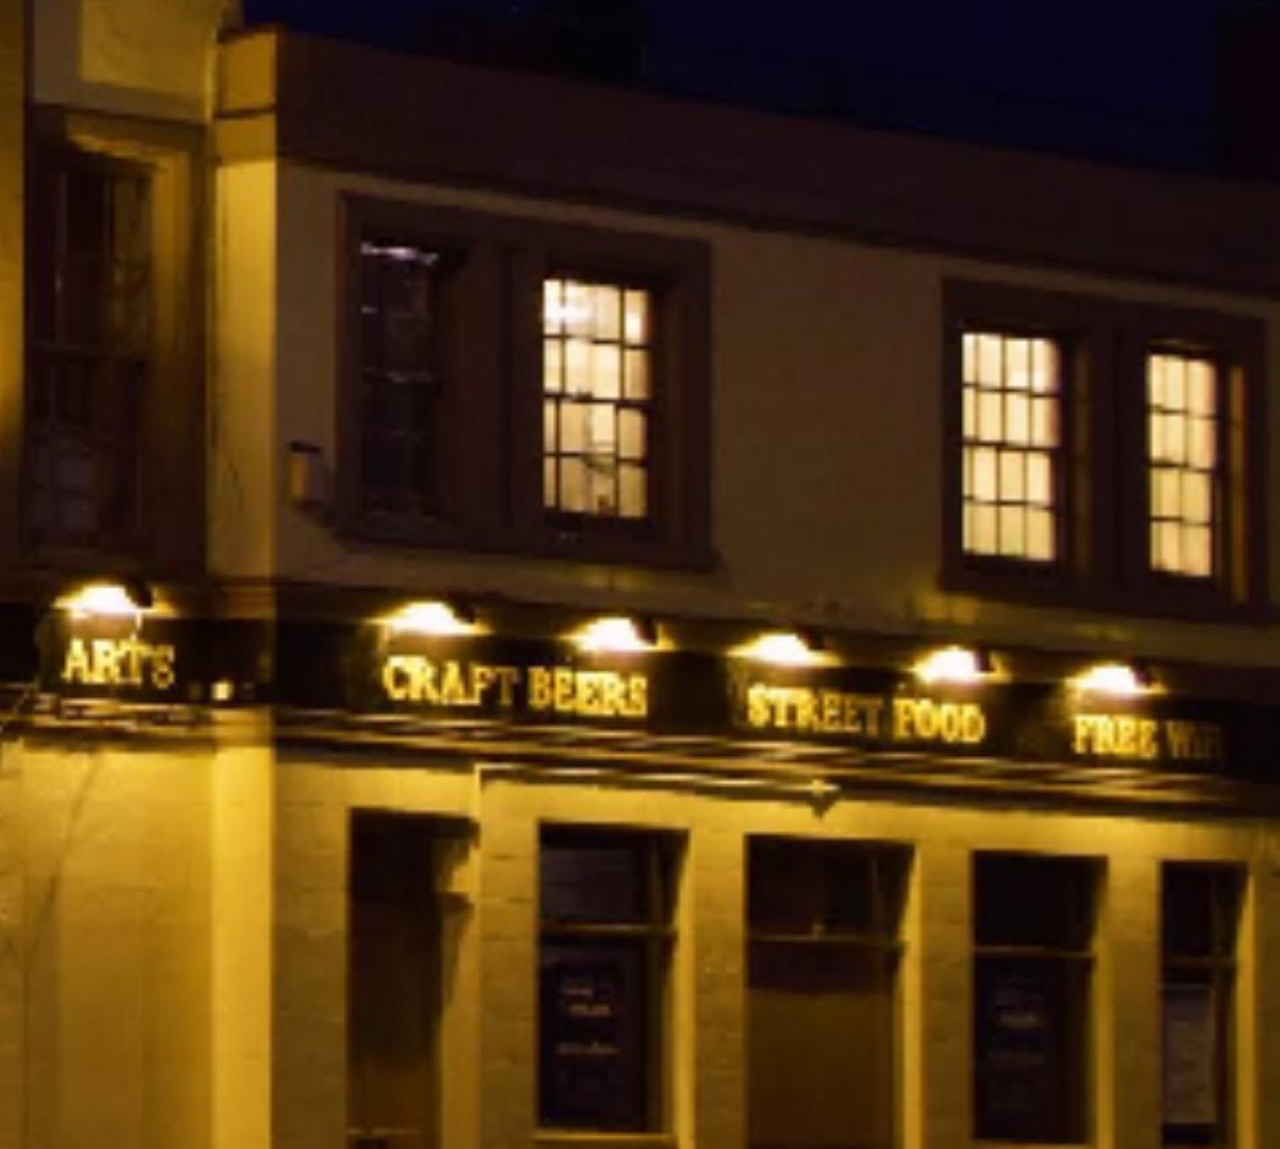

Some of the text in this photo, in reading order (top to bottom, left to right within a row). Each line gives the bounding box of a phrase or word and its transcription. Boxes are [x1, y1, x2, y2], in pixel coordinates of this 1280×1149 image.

[61, 637, 176, 690] ARTS
[380, 655, 648, 719] CRAFT BEERS
[746, 686, 987, 745] STREET FOOD
[1073, 711, 1158, 761] FREE
